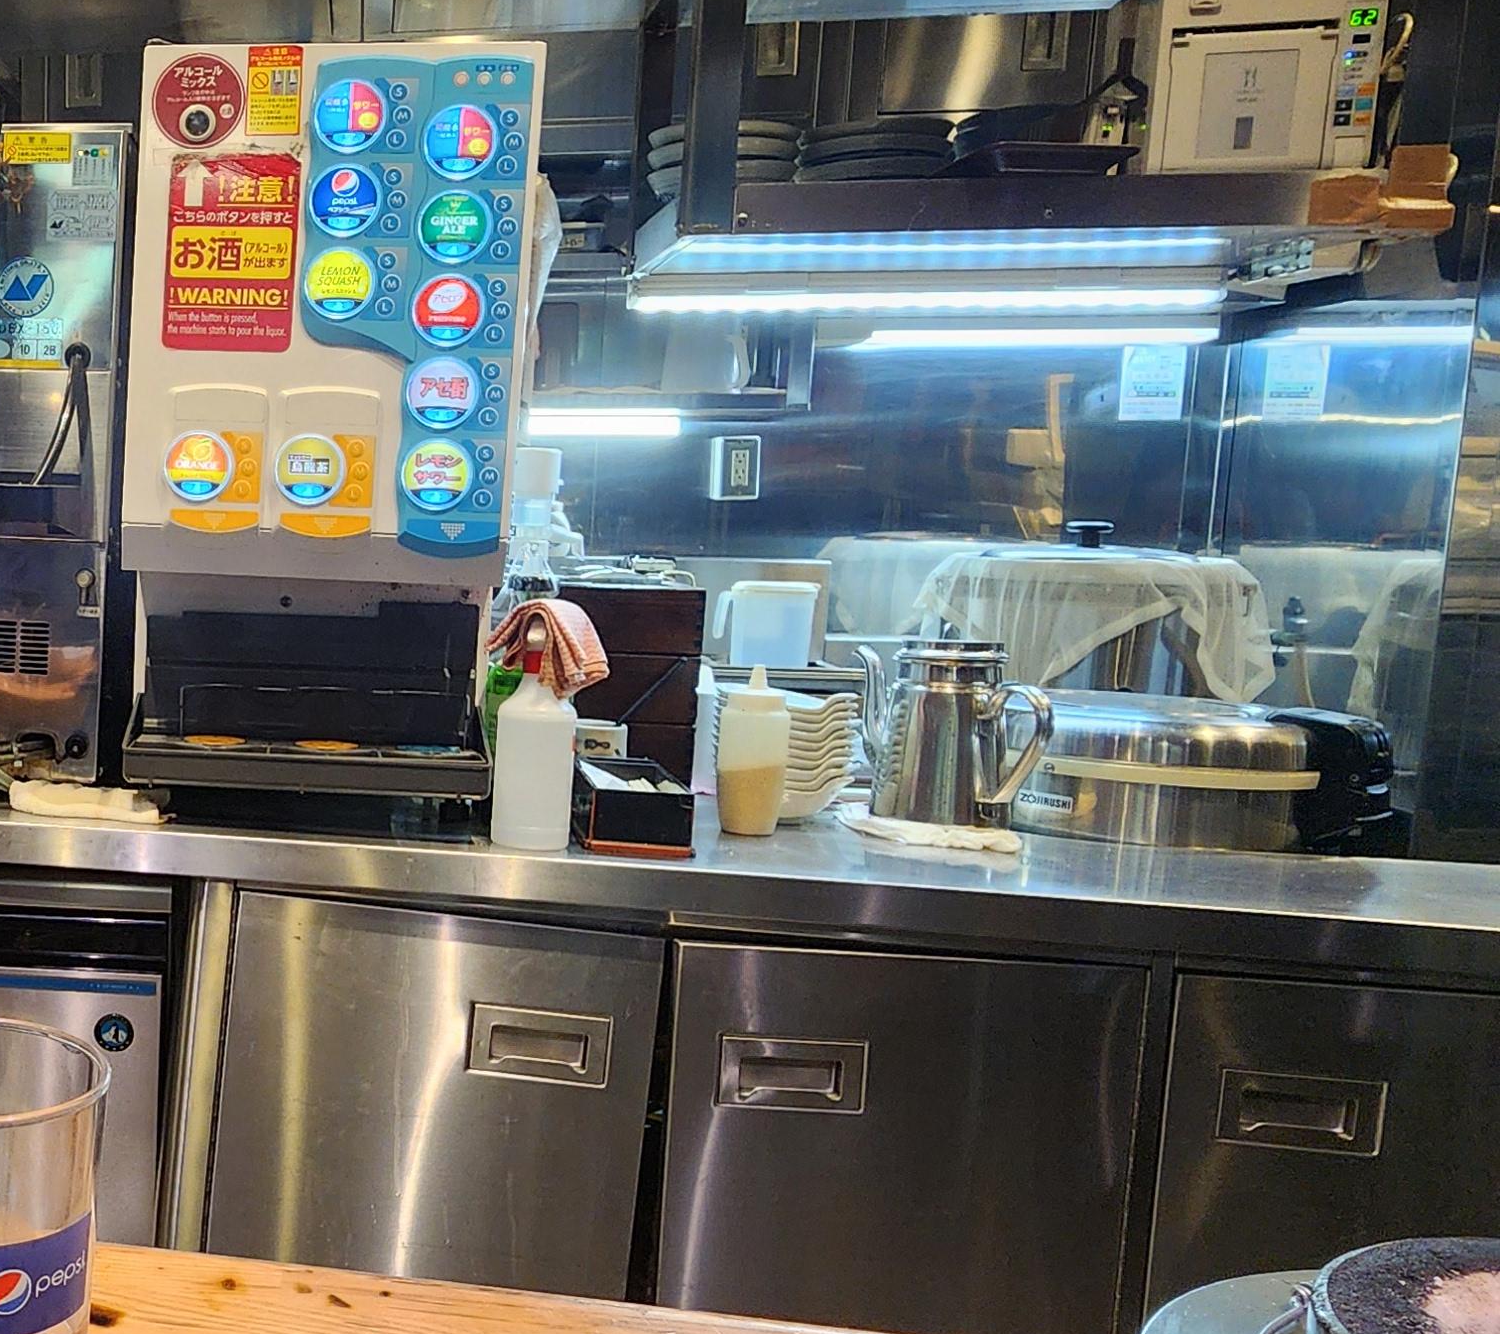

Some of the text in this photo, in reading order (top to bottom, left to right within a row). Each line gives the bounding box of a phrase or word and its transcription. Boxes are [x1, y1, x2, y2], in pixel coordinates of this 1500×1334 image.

[1349, 9, 1378, 27] 62
[173, 65, 223, 78] アルコール
[180, 76, 217, 88] ミックス
[173, 210, 293, 225] こちらのボタンを押すと
[430, 215, 478, 226] GINGER
[442, 224, 466, 234] ALE
[173, 236, 243, 271] お酒
[244, 242, 288, 254] (アルコール)
[243, 257, 288, 268] が出ます
[320, 266, 361, 276] LEMON
[317, 275, 362, 286] SQUASH
[419, 376, 469, 400] アセ酎
[414, 453, 464, 468] レモン
[413, 470, 462, 485] サワー
[1019, 792, 1072, 811] ZOJIRUSHI
[35, 1249, 86, 1298] pepsi
